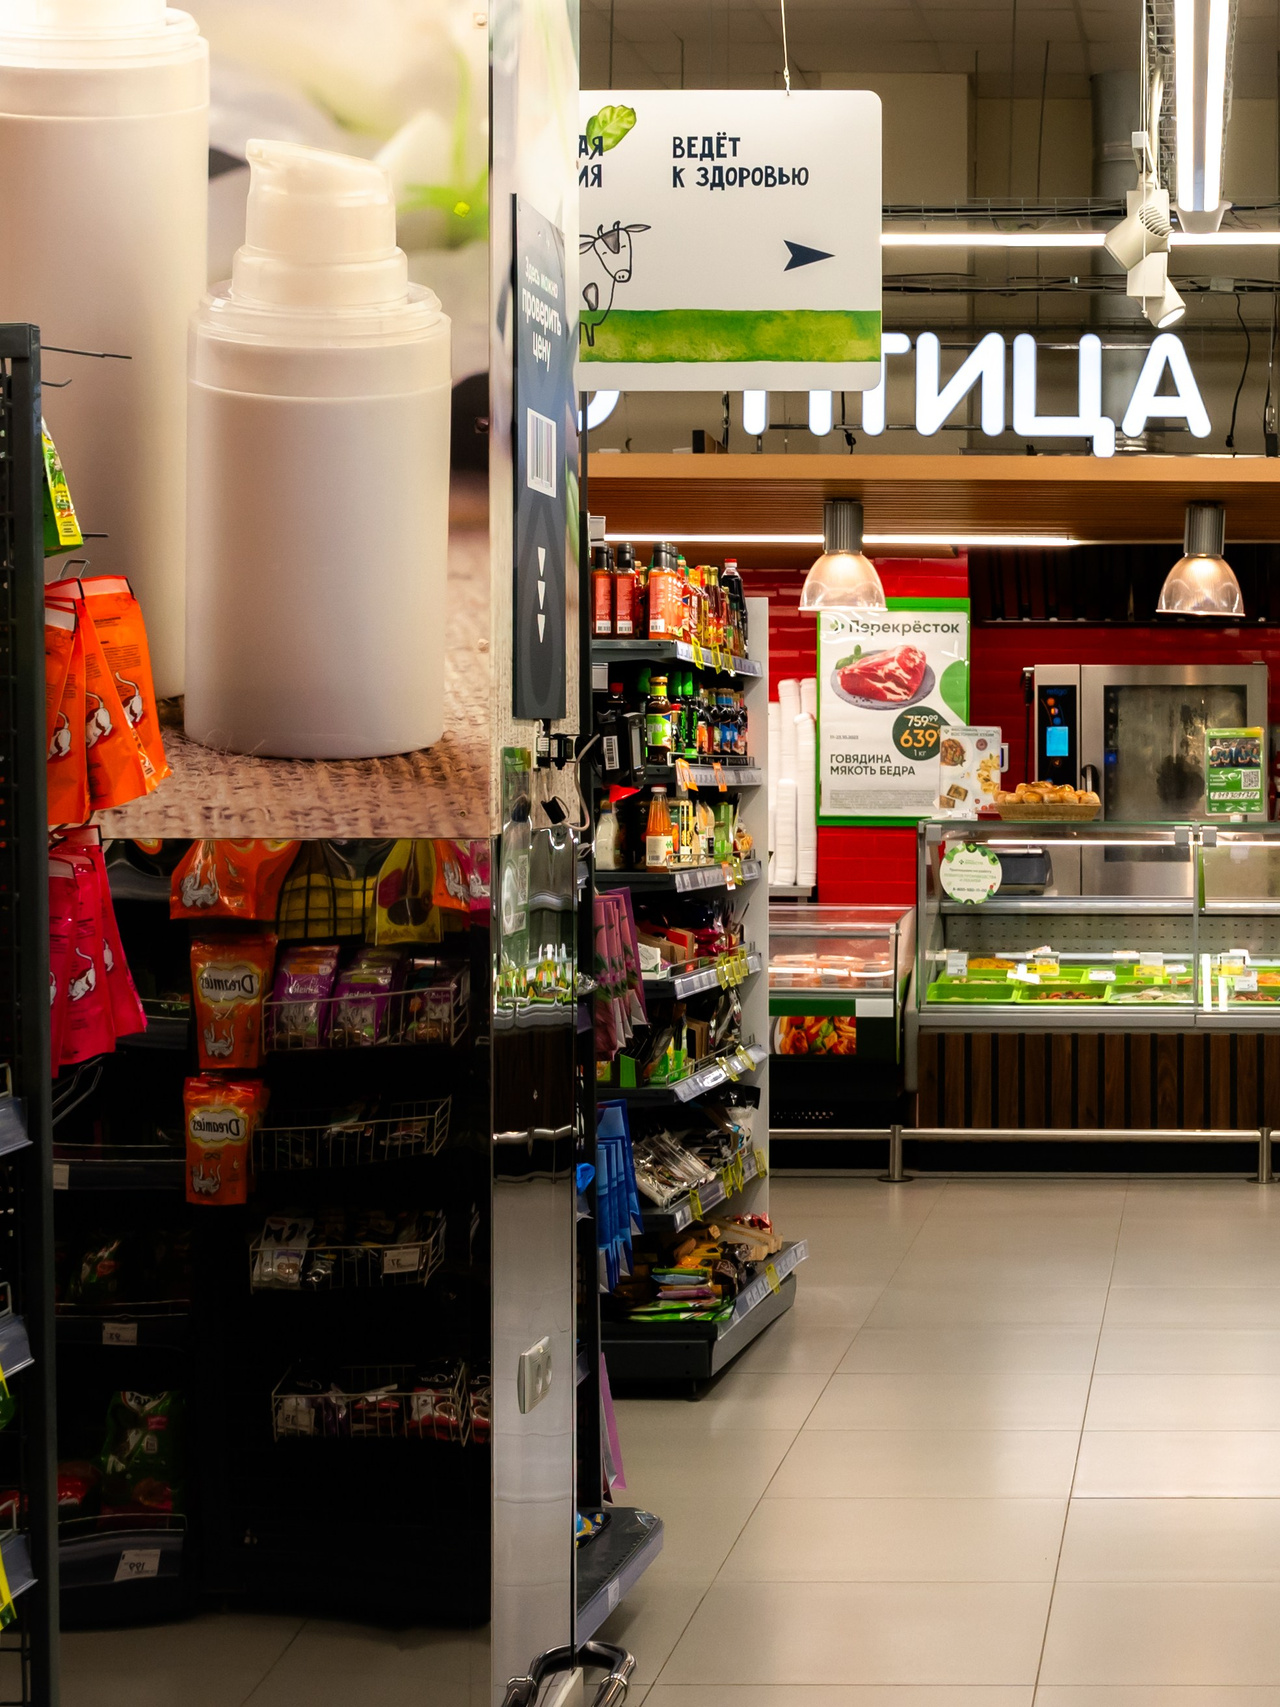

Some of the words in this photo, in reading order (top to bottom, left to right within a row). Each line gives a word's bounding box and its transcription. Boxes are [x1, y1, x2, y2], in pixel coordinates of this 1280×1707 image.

[672, 131, 741, 161] ВЕДЁТ
[672, 167, 685, 188] К
[696, 166, 809, 190] ЗДОРОВЬЮ
[525, 256, 541, 287] Здесь
[522, 287, 562, 336] проверить
[532, 331, 551, 372] цену
[849, 619, 959, 636] Перекрёсток
[907, 715, 928, 727] 759
[900, 730, 937, 748] 639
[830, 754, 892, 764] ГОВЯДИНА
[830, 766, 876, 775] МЯКОТЬ
[879, 766, 915, 776] БЕДРА
